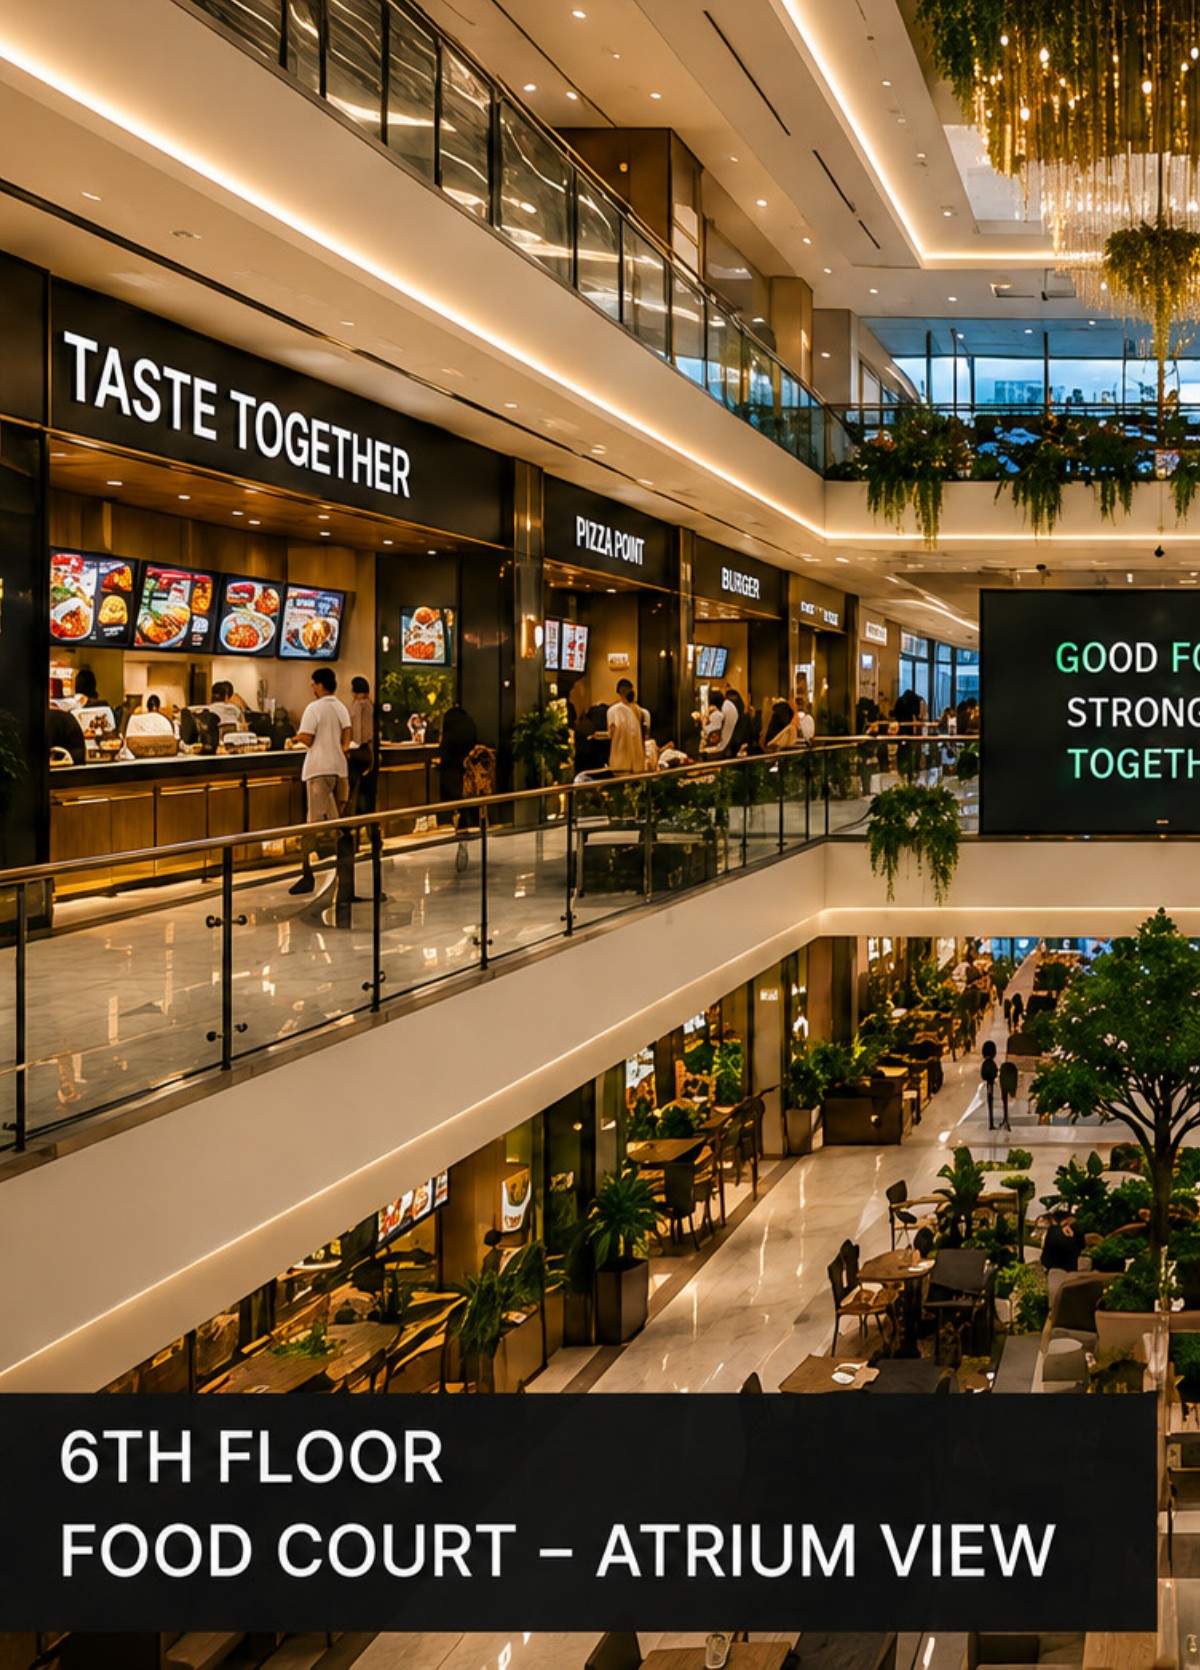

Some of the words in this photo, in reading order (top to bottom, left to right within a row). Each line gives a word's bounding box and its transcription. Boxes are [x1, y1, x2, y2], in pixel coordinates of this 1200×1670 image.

[63, 330, 217, 441] TASTE
[229, 389, 411, 498] TOGETHER
[576, 515, 614, 557] PIZZA
[1056, 641, 1158, 673] GOOD
